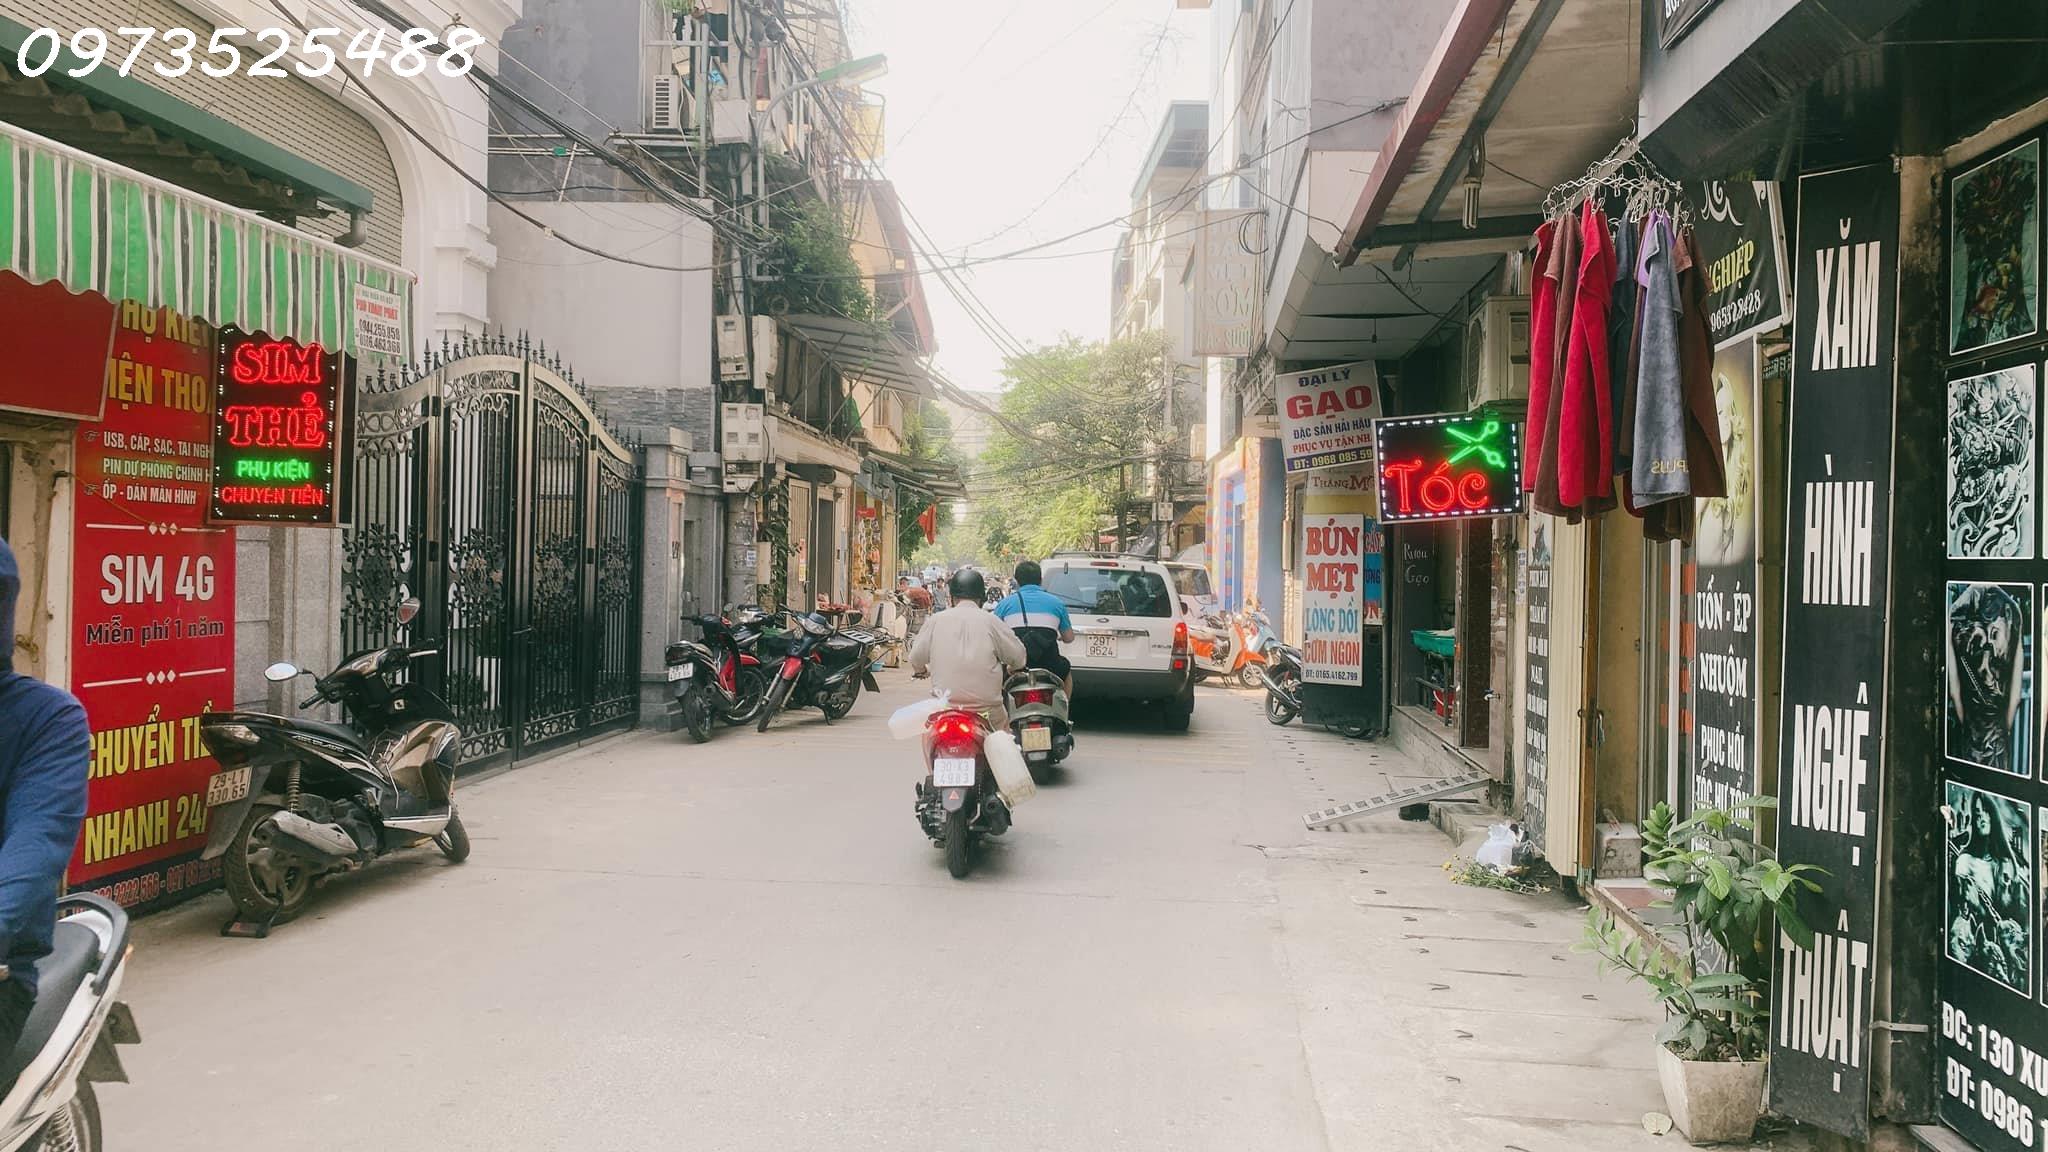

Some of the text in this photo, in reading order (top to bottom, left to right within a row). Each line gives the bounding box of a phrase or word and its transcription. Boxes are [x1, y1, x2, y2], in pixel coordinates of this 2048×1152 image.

[1709, 237, 1754, 294] GHIỆP
[1812, 217, 1880, 371] XĂM
[233, 342, 322, 384] SIM
[1298, 368, 1351, 388] ĐẠI LÝ
[161, 370, 212, 414] THO
[1286, 384, 1373, 420] GẠO
[225, 391, 325, 448] THẺ
[1314, 421, 1333, 436] SẢN
[1335, 418, 1350, 433] HẢI
[104, 431, 128, 450] USB,
[178, 441, 191, 456] TAI
[1293, 443, 1317, 454] PHỤC
[1319, 440, 1333, 451] VỤ
[1356, 433, 1373, 444] NH
[1312, 453, 1336, 467] 0968
[1338, 450, 1357, 463] 085
[103, 458, 121, 474] PIN
[124, 460, 139, 480] DỰ
[140, 460, 173, 479] PHÒNG
[175, 464, 203, 482] CHÍNH
[236, 458, 310, 482] PHỤ KIỆN
[127, 483, 148, 501] DÁN
[150, 485, 172, 503] MÀN
[174, 487, 197, 505] HÌNH
[1306, 519, 1361, 556] BÚN
[1803, 454, 1874, 606] HÌNH
[101, 555, 215, 605] SIM 4G
[1306, 562, 1358, 599] MẸT
[1305, 600, 1335, 632] LÒNG
[1338, 596, 1358, 634] DỒI
[1697, 574, 1724, 631] UỐN
[1733, 581, 1752, 633] ÉP
[86, 615, 224, 647] Miễn phí 1 năm
[1330, 640, 1360, 666] NGON
[1700, 644, 1747, 707] NHUỘM
[1701, 724, 1726, 771] PHỤC
[1791, 682, 1869, 866] NGHỆ
[84, 799, 169, 865] NHANH
[1780, 909, 1867, 1093] THUẬT
[1942, 1001, 1973, 1051] ĐC:
[1978, 1024, 2014, 1076] 130
[1947, 1056, 1975, 1109] ĐT:
[1981, 1080, 2033, 1148] 0986
